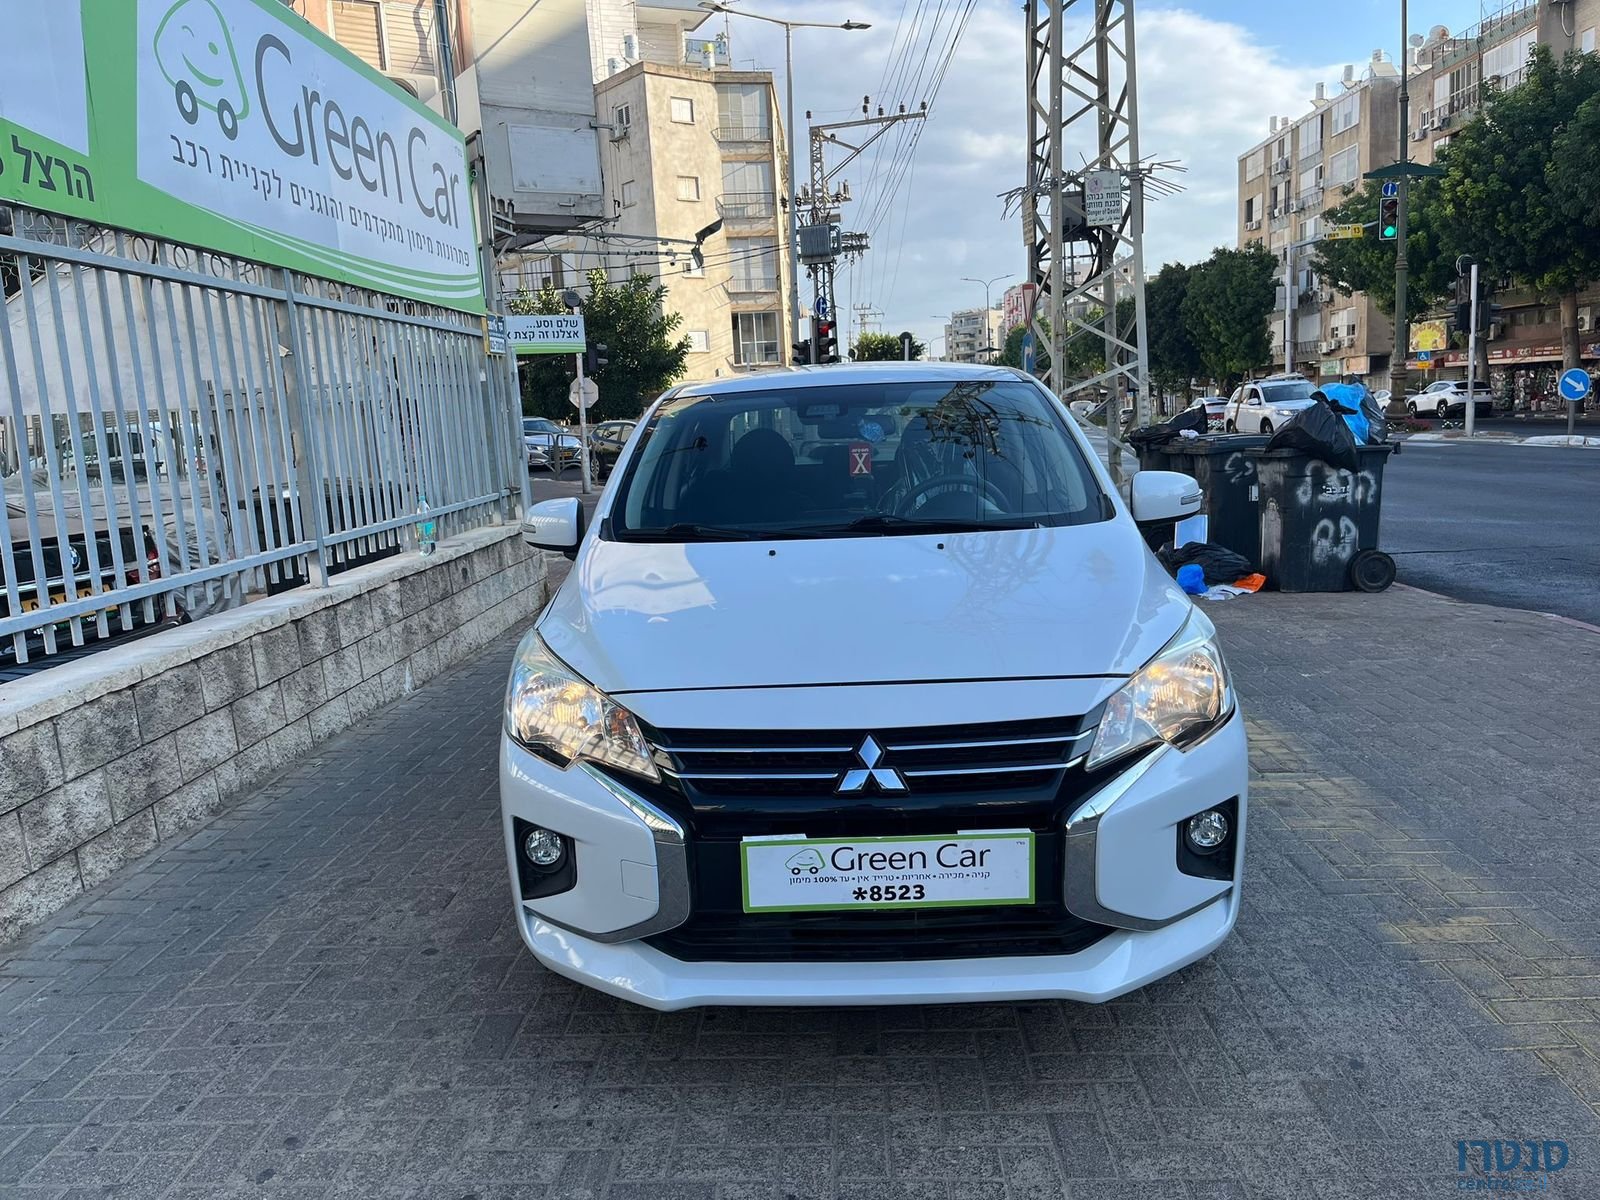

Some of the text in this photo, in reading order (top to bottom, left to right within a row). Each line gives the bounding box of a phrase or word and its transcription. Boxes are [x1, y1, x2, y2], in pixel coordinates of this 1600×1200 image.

[255, 33, 460, 229] Green Car
[11, 134, 95, 202] הרצל
[170, 134, 470, 267] פתרונות מימון מתקדמים והוגנים לקניית רכב
[556, 318, 578, 328] שלם
[514, 331, 535, 341] קצת
[538, 331, 549, 339] זה
[552, 330, 579, 339] אצלנו
[831, 843, 991, 871] Green Car
[857, 875, 869, 883] אין
[971, 871, 990, 879] קניה
[789, 877, 811, 886] מימון
